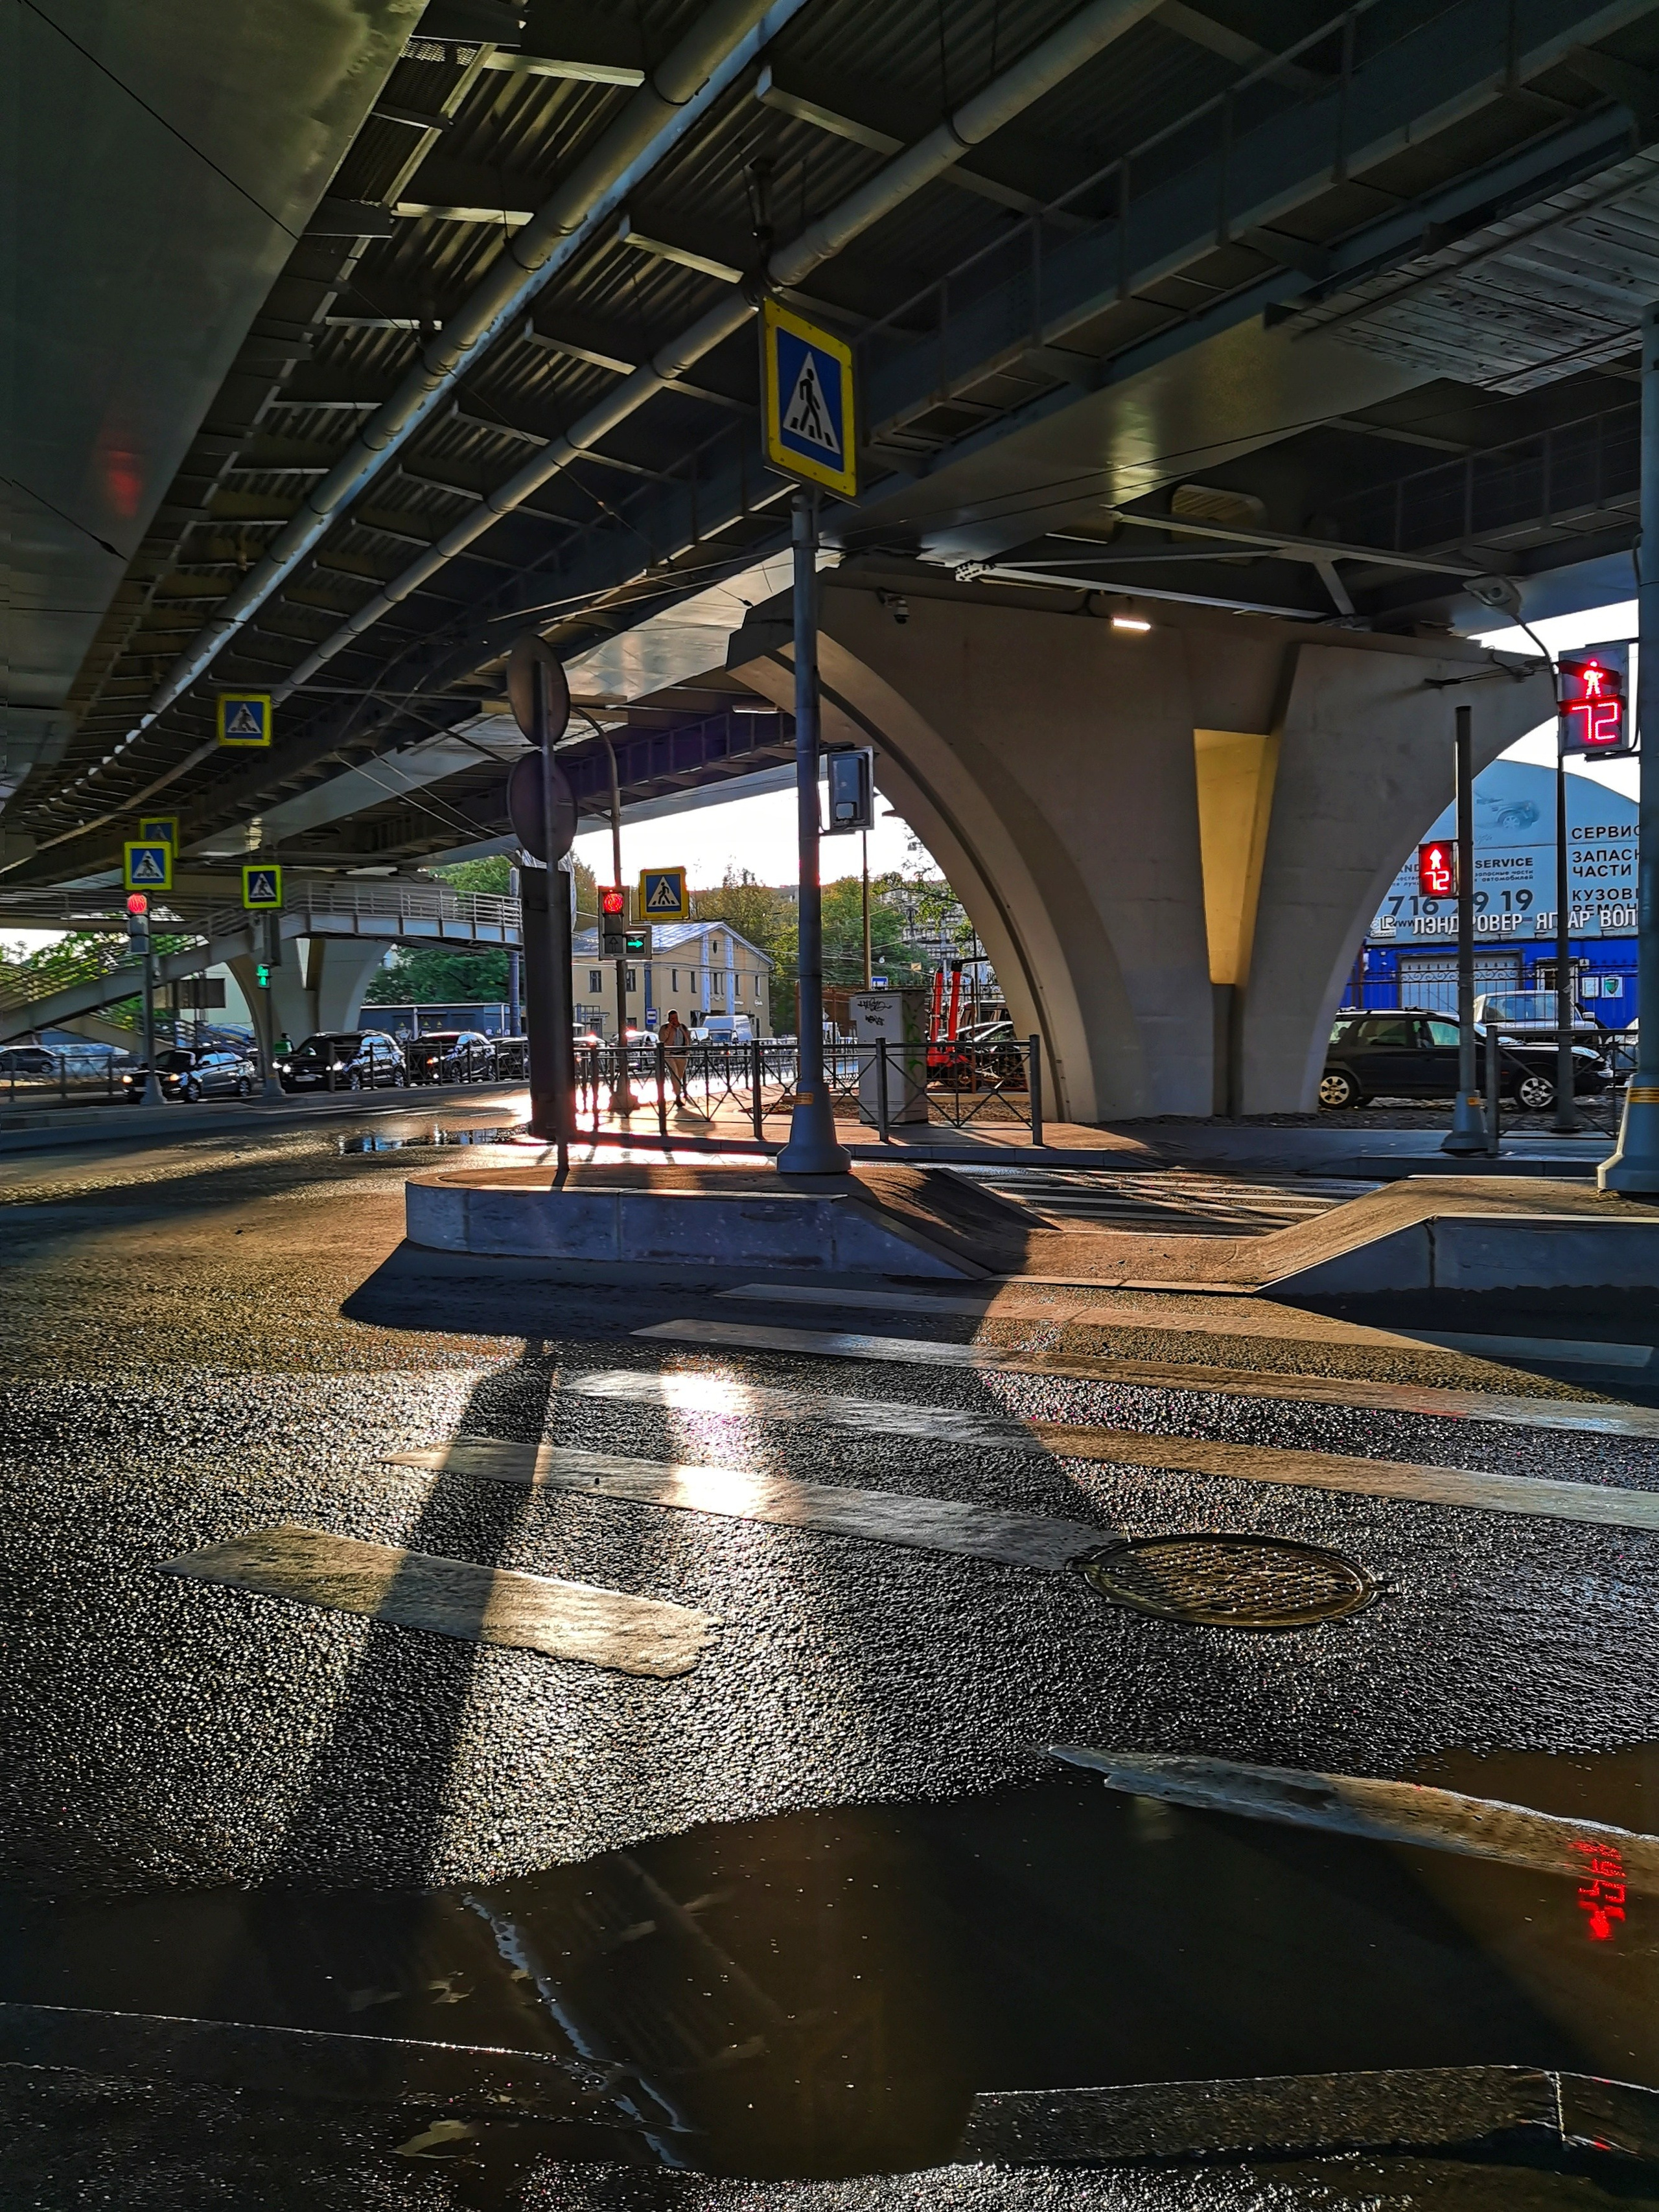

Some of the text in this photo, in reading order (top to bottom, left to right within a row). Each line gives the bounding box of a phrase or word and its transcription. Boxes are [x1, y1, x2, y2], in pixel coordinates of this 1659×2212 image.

[1572, 702, 1618, 740] 72
[1475, 857, 1533, 869] SERVICE
[1573, 864, 1631, 877] ЧАСТИ
[1424, 870, 1450, 891] 72
[1388, 895, 1439, 916] 716
[1500, 889, 1533, 912] 19
[1413, 916, 1459, 935] ЛЭНД
